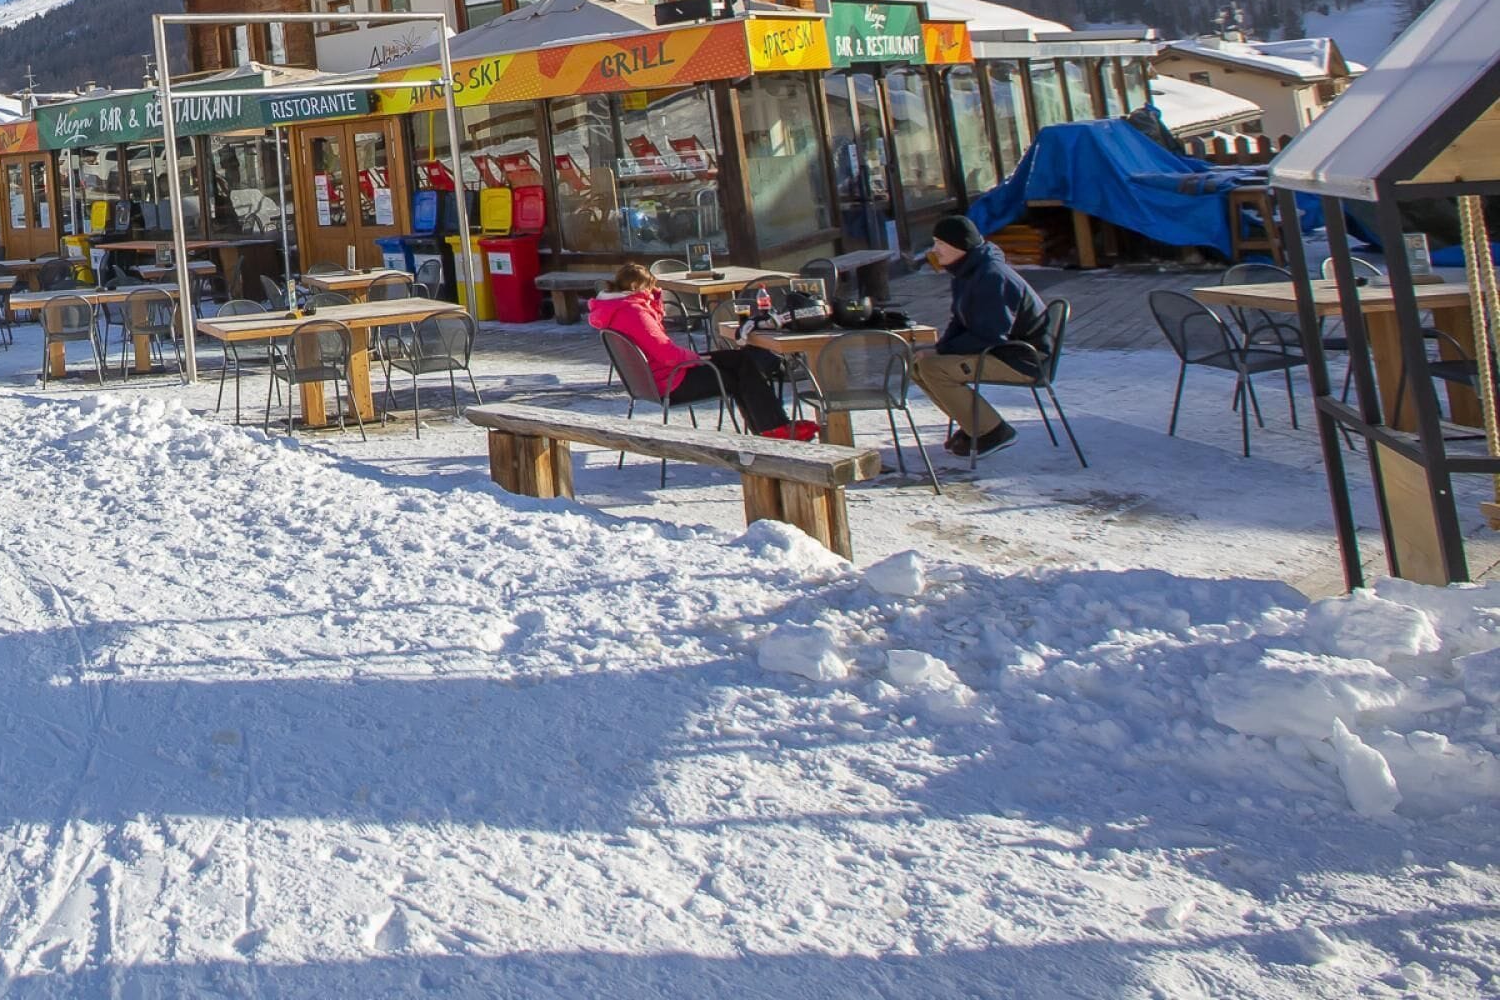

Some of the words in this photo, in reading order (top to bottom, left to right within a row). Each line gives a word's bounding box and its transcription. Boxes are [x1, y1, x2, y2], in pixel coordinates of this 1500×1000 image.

[763, 28, 795, 60] APRES
[795, 20, 815, 49] SKI
[835, 35, 854, 57] BAR
[856, 38, 864, 55] &
[865, 34, 920, 56] RESTAURANT
[469, 60, 501, 89] SKI
[600, 39, 675, 79] GRILL
[54, 111, 93, 144] Alegra
[99, 107, 124, 132] BAR
[129, 108, 140, 128] &
[145, 96, 242, 128] RETAURANT
[270, 92, 357, 119] RISTORANTE
